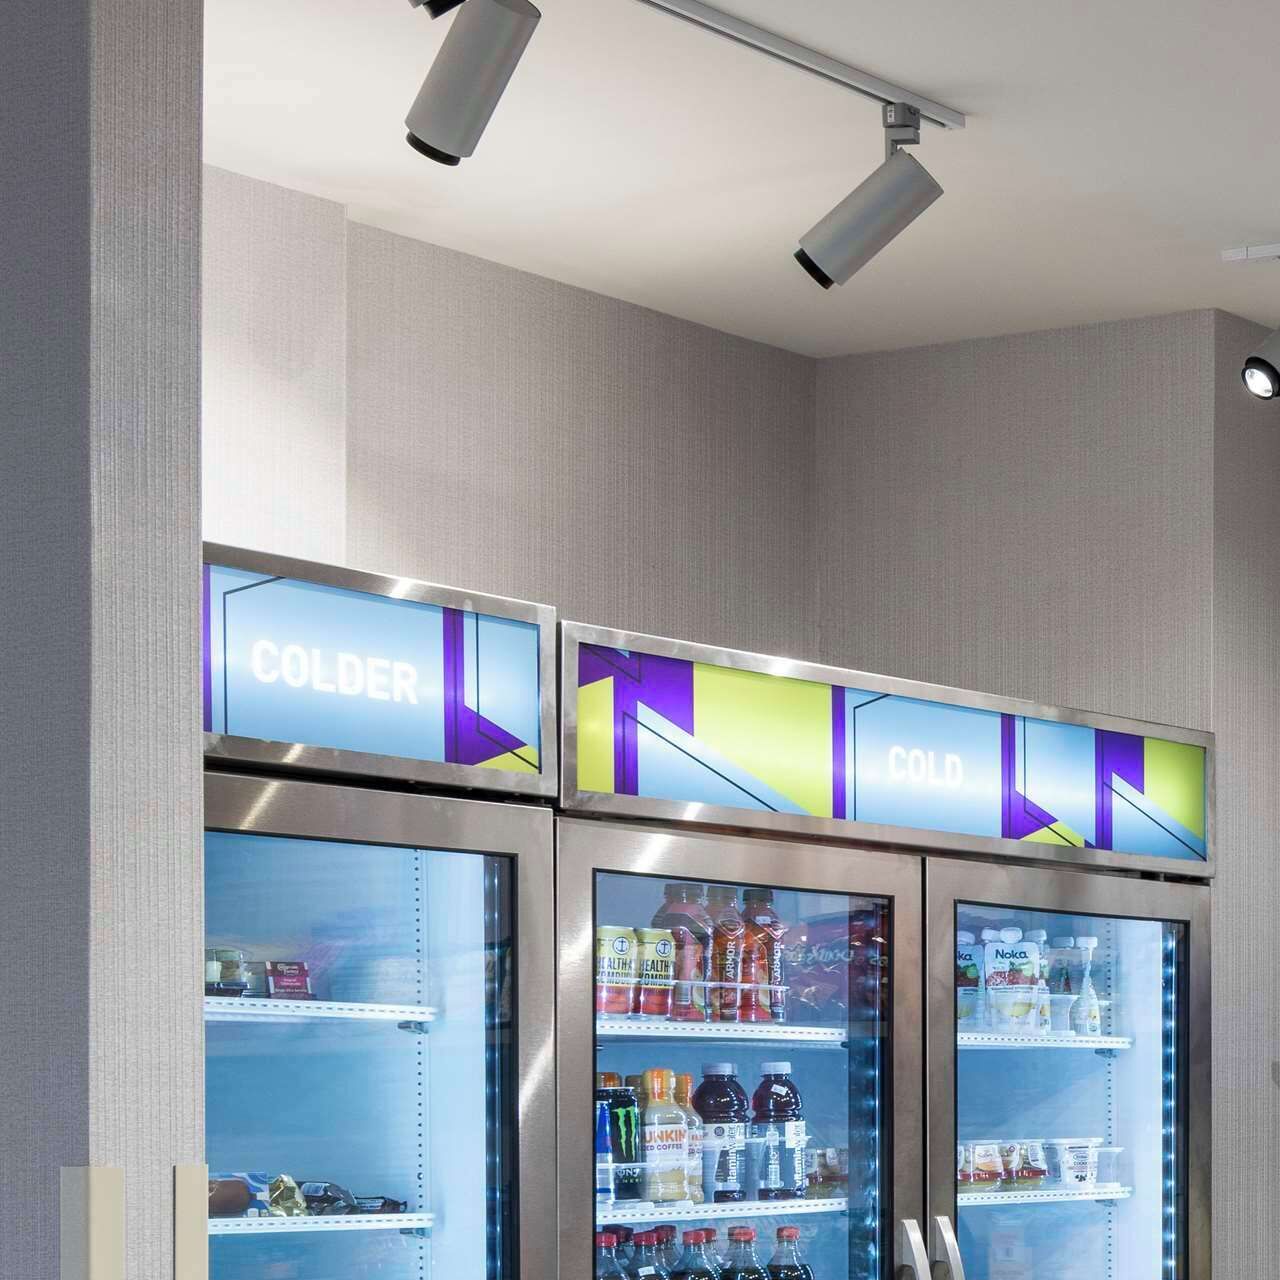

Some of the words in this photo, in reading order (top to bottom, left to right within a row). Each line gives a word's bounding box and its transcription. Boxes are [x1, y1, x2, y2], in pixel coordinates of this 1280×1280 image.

[250, 638, 420, 705] COLDER
[887, 744, 965, 788] COLD
[995, 949, 1029, 960] Noka
[656, 1143, 683, 1151] COFFEE
